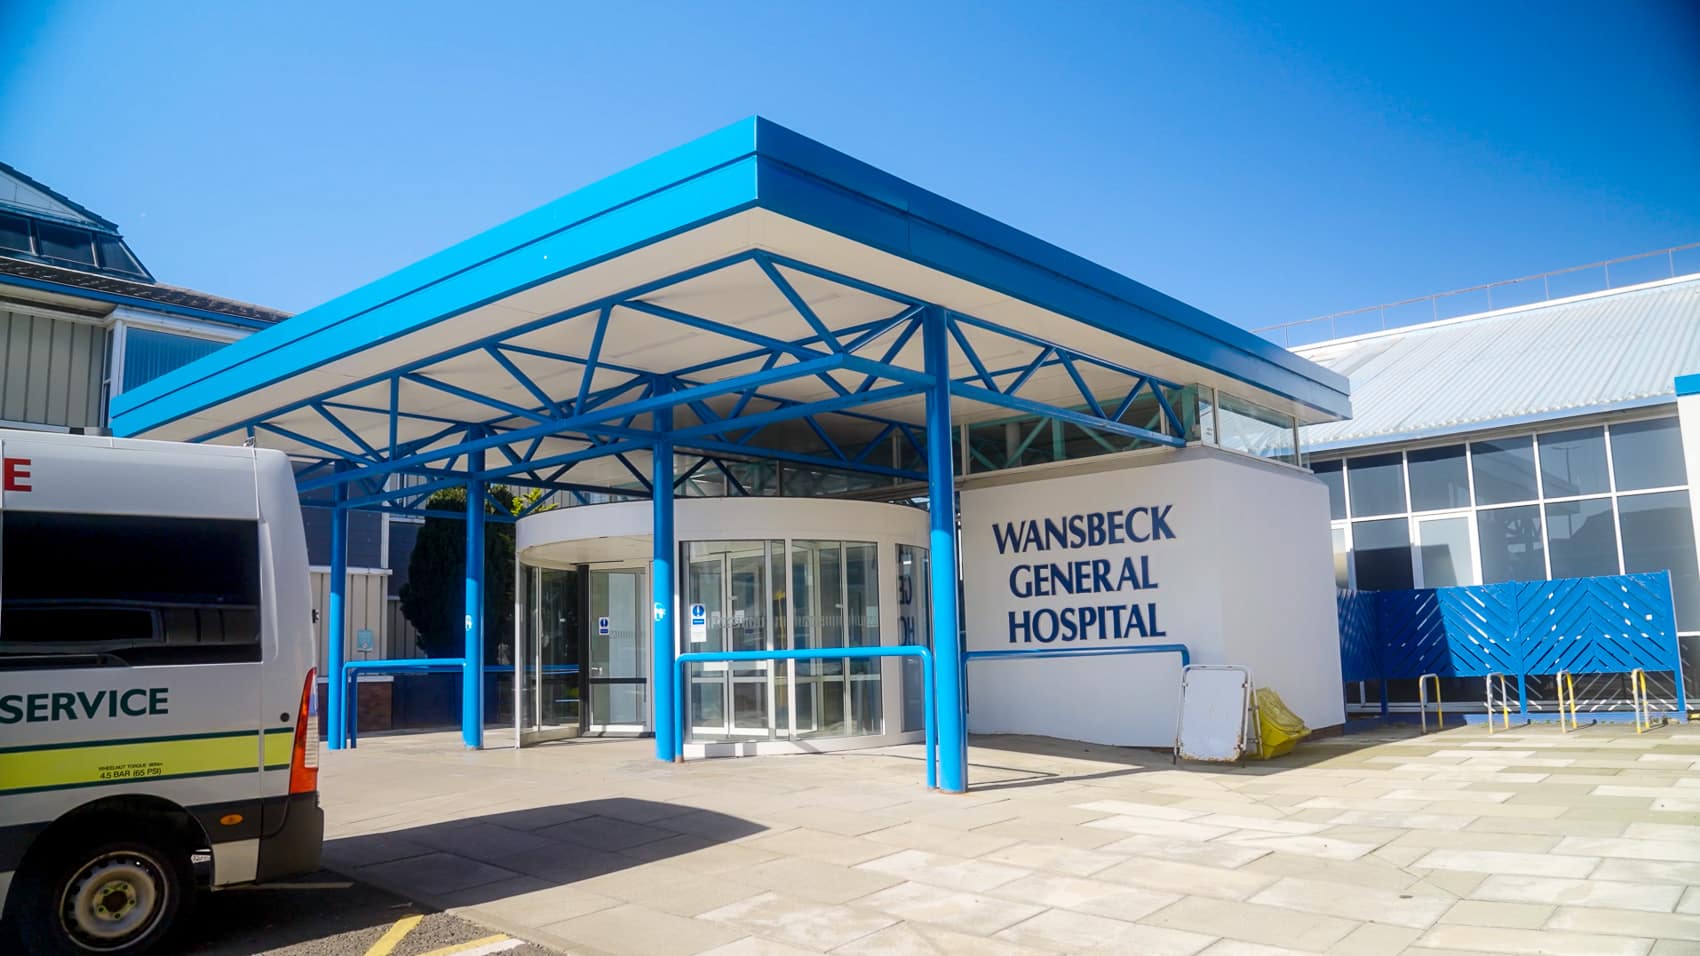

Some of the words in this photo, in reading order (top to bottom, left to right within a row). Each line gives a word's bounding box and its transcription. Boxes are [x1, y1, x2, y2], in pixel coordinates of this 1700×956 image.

[992, 504, 1177, 555] WANSBECK
[1009, 555, 1159, 599] GENERAL
[1008, 602, 1167, 644] HOSPITAL
[0, 687, 169, 725] SERVICE
[132, 769, 146, 777] (65
[147, 768, 161, 776] PSI)
